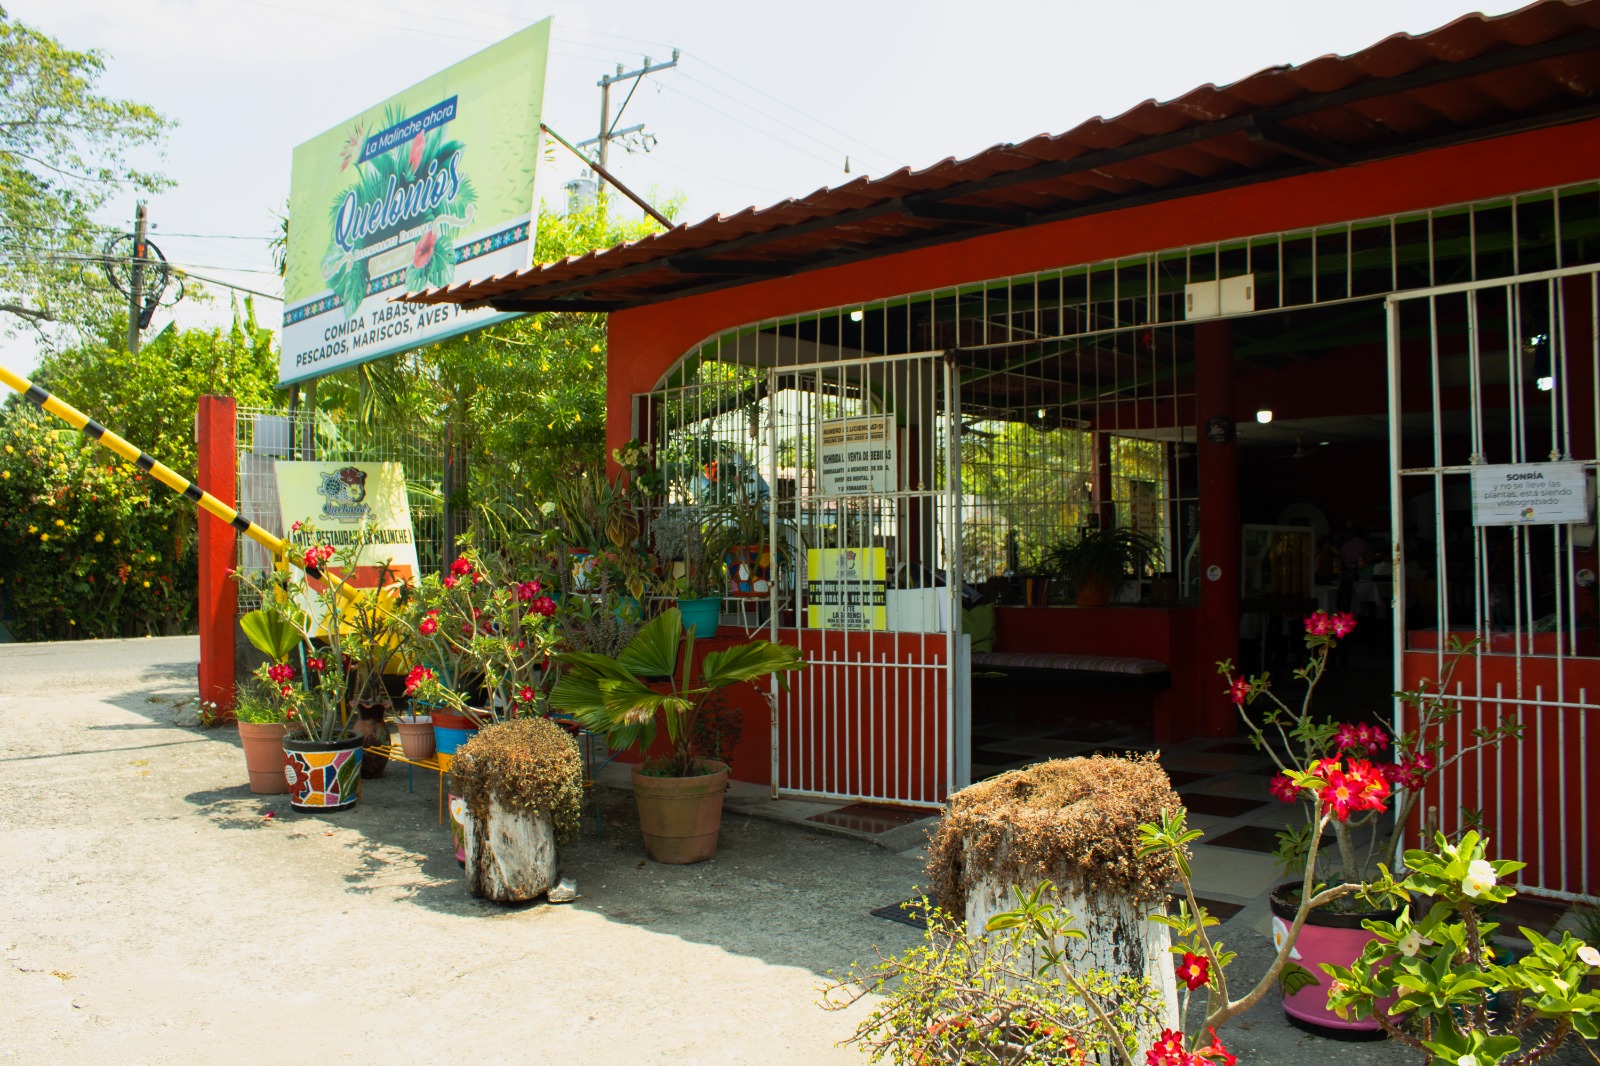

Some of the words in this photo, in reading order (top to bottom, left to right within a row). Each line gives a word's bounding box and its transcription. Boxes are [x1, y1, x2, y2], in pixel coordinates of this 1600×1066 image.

[365, 140, 378, 156] La
[378, 120, 422, 149] Malinche
[423, 104, 454, 128] ahora
[335, 150, 465, 253] Quelonios
[324, 316, 365, 342] COMIDA
[372, 301, 429, 326] TABASQU
[296, 340, 349, 367] PESCADOS,
[353, 318, 413, 350] MARISCOS,
[417, 305, 449, 329] AVES
[848, 451, 862, 462] VENTA
[863, 451, 869, 461] DE
[1506, 471, 1543, 481] SONRÍA
[1493, 484, 1499, 492] y
[1526, 481, 1546, 489] lleve
[1548, 480, 1561, 488] las
[1520, 489, 1539, 497] está
[1541, 487, 1573, 496] siendo
[1497, 498, 1559, 508] videograbado
